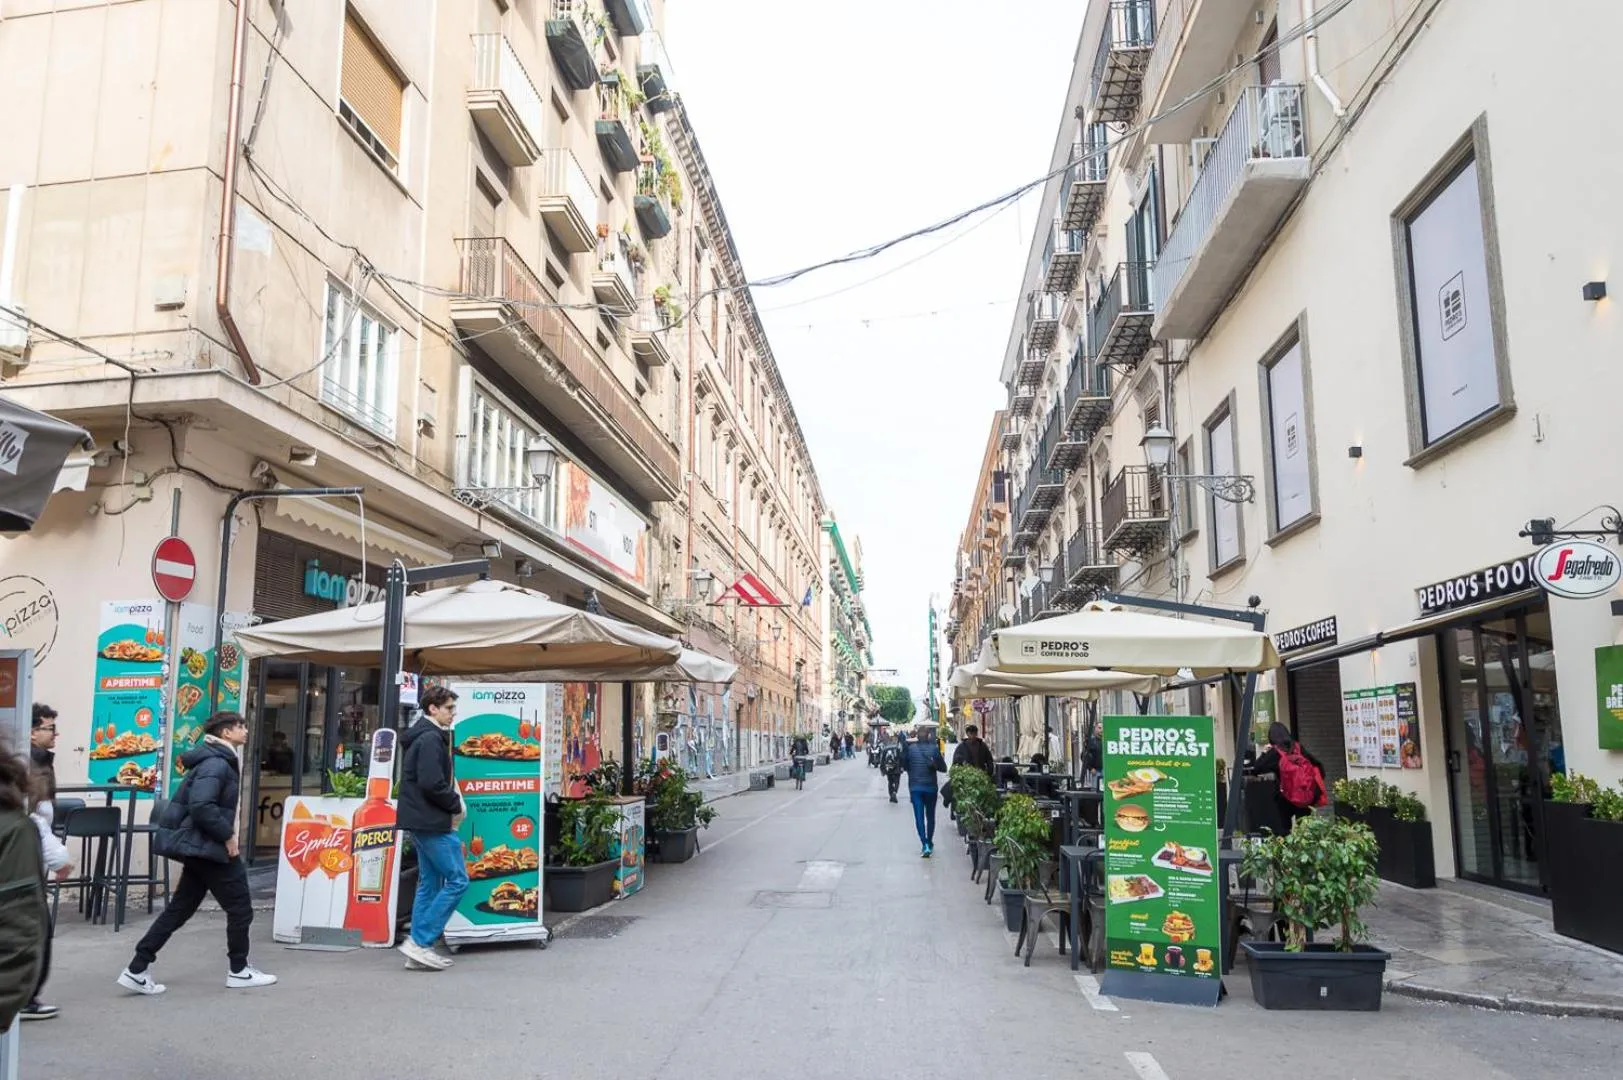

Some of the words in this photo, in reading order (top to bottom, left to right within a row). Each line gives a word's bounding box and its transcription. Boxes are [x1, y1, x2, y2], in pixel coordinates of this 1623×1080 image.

[1548, 549, 1613, 580] Segafredo
[1419, 574, 1479, 609] PEDRO'S
[188, 622, 203, 634] Food
[1306, 618, 1336, 642] COFFEE
[1041, 641, 1089, 651] PEDRO'S
[106, 677, 155, 688] APERITIME
[473, 689, 526, 704] iampizza
[1119, 727, 1196, 743] PEDRO'S
[1107, 740, 1209, 757] BREAKFAST
[465, 780, 535, 791] APERITIME
[288, 828, 346, 863] Spritz
[354, 830, 394, 849] APEROL
